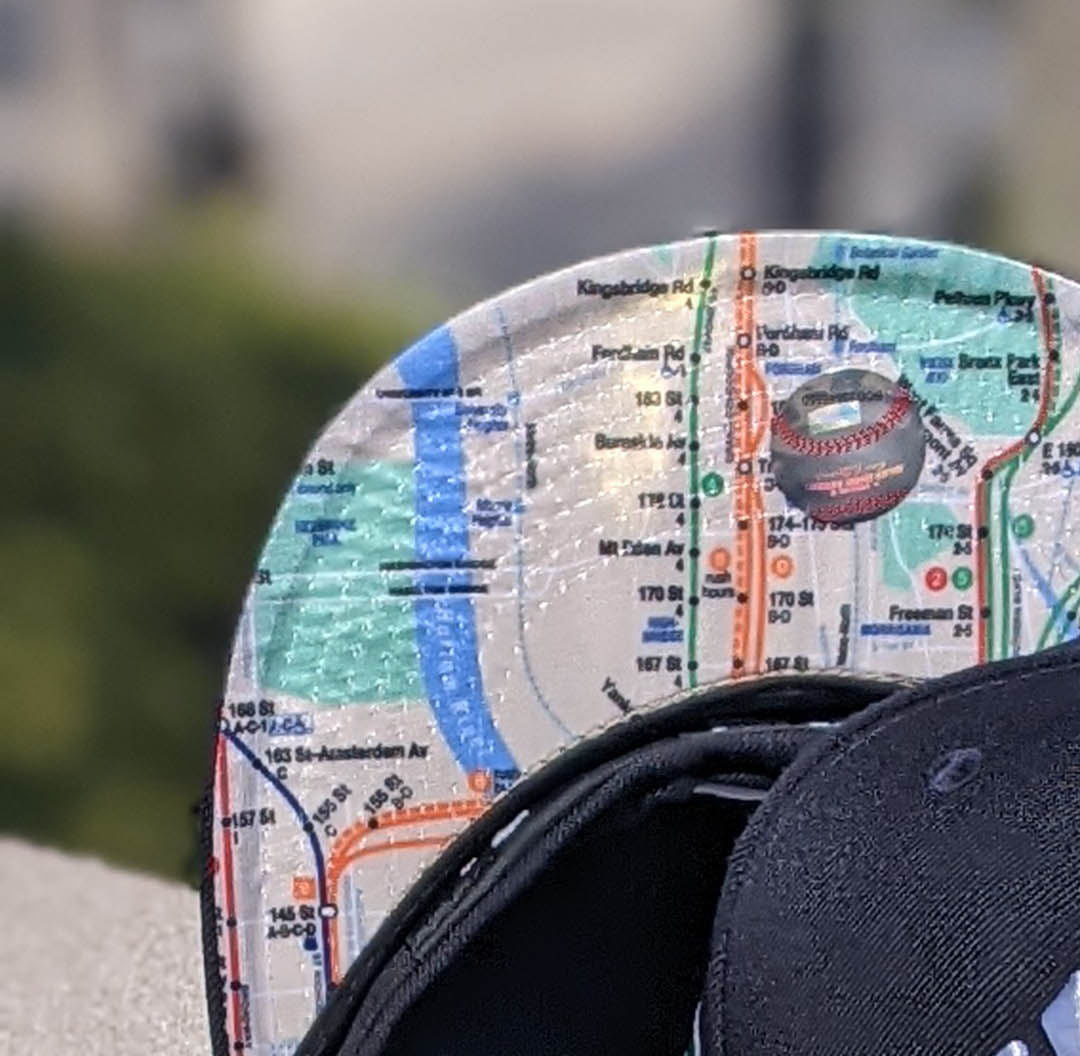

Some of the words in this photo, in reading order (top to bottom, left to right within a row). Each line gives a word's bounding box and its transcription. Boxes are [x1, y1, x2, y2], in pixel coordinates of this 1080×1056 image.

[764, 264, 855, 282] Kingsbridge
[858, 265, 880, 280] Rd
[577, 280, 667, 299] Kingsbridge
[672, 280, 693, 294] Rd
[637, 585, 664, 602] 170
[667, 585, 684, 601] St
[768, 591, 795, 607] 170
[797, 591, 815, 607] St
[888, 605, 954, 621] Freeman
[957, 604, 974, 621] St
[665, 656, 682, 671] St
[265, 746, 293, 763] 163
